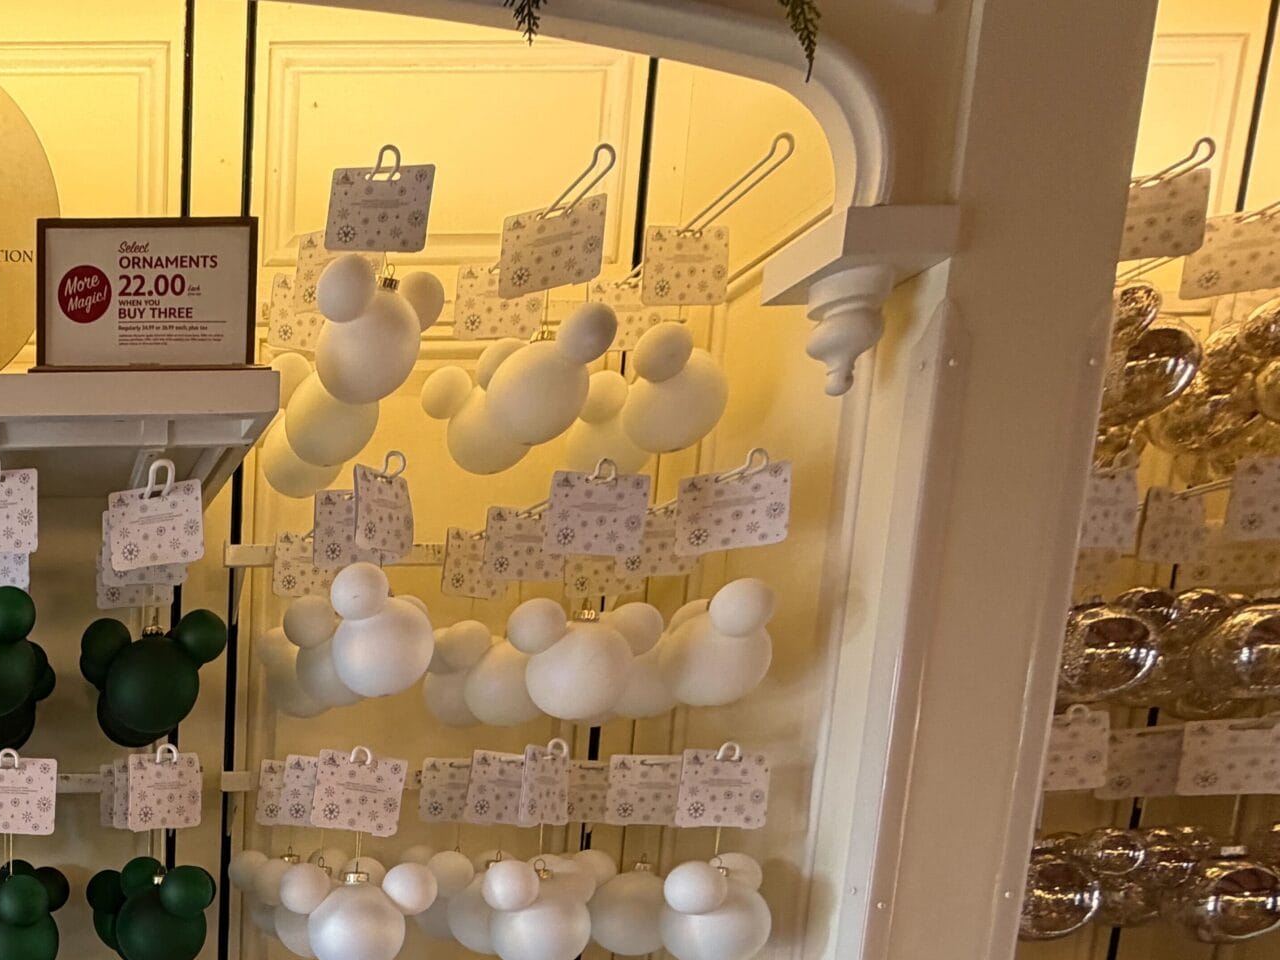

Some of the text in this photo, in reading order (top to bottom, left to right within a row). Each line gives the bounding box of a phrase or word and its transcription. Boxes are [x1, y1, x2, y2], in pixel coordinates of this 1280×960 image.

[118, 241, 150, 253] Select
[119, 255, 218, 269] ORNAMENTS
[64, 274, 101, 297] More
[118, 274, 186, 297] 22.00
[67, 284, 108, 314] Magic!
[118, 299, 143, 307] WHEN
[118, 307, 193, 320] BUY THREE
